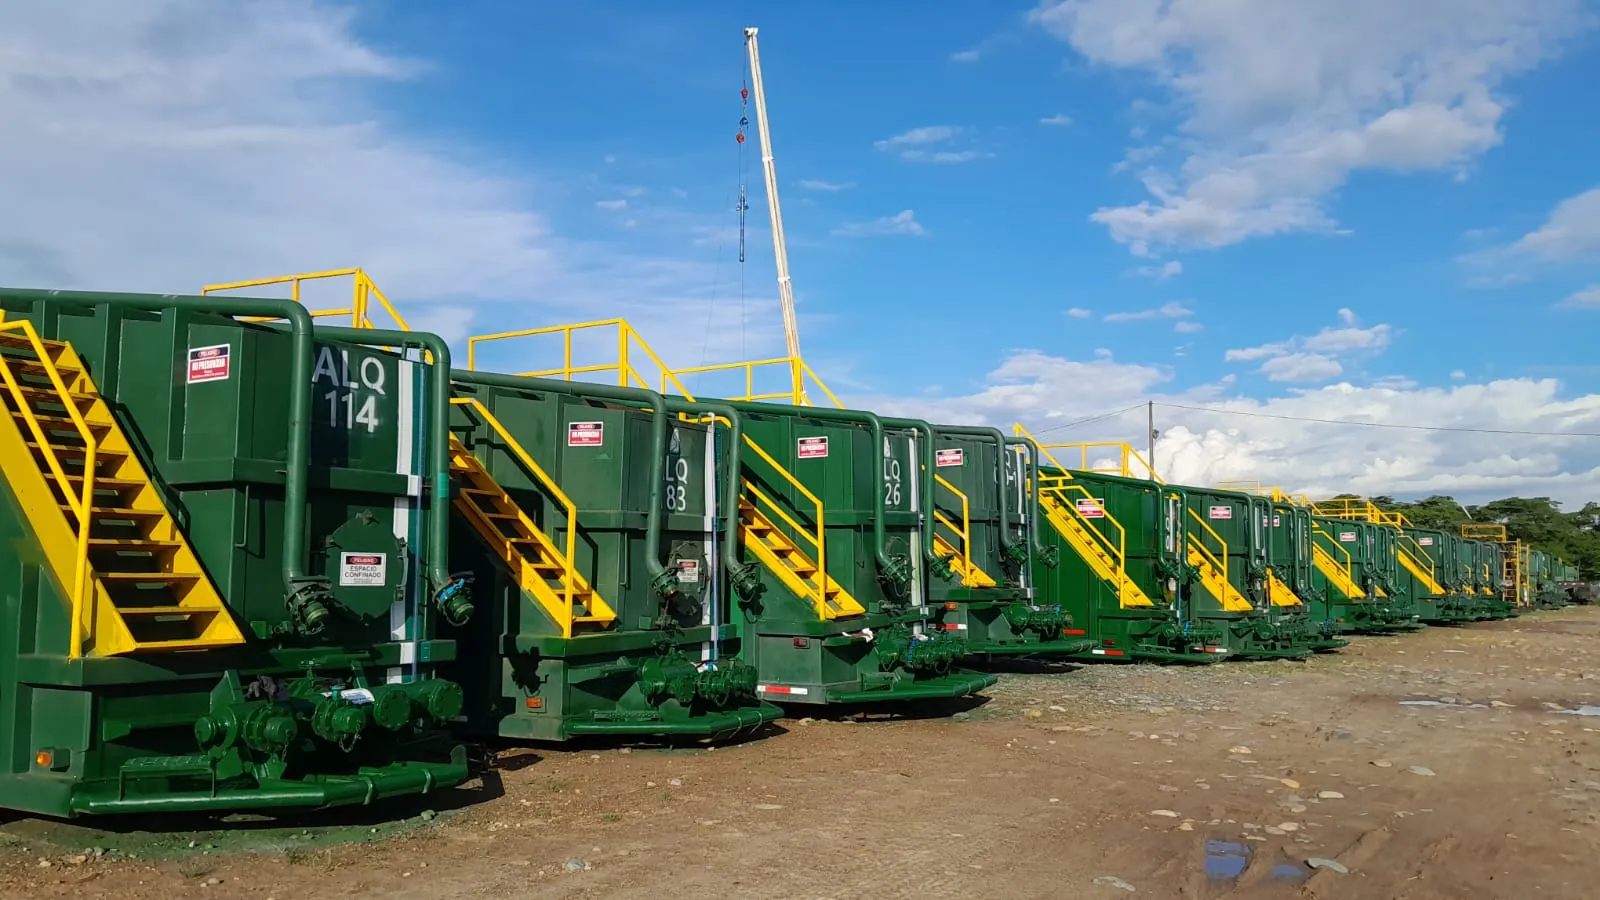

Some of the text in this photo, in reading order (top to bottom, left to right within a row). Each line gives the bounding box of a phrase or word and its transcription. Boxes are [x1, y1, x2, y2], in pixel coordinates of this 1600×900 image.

[311, 346, 386, 396] ALQ
[325, 390, 379, 433] 114
[666, 485, 686, 512] 83
[885, 482, 901, 505] 26
